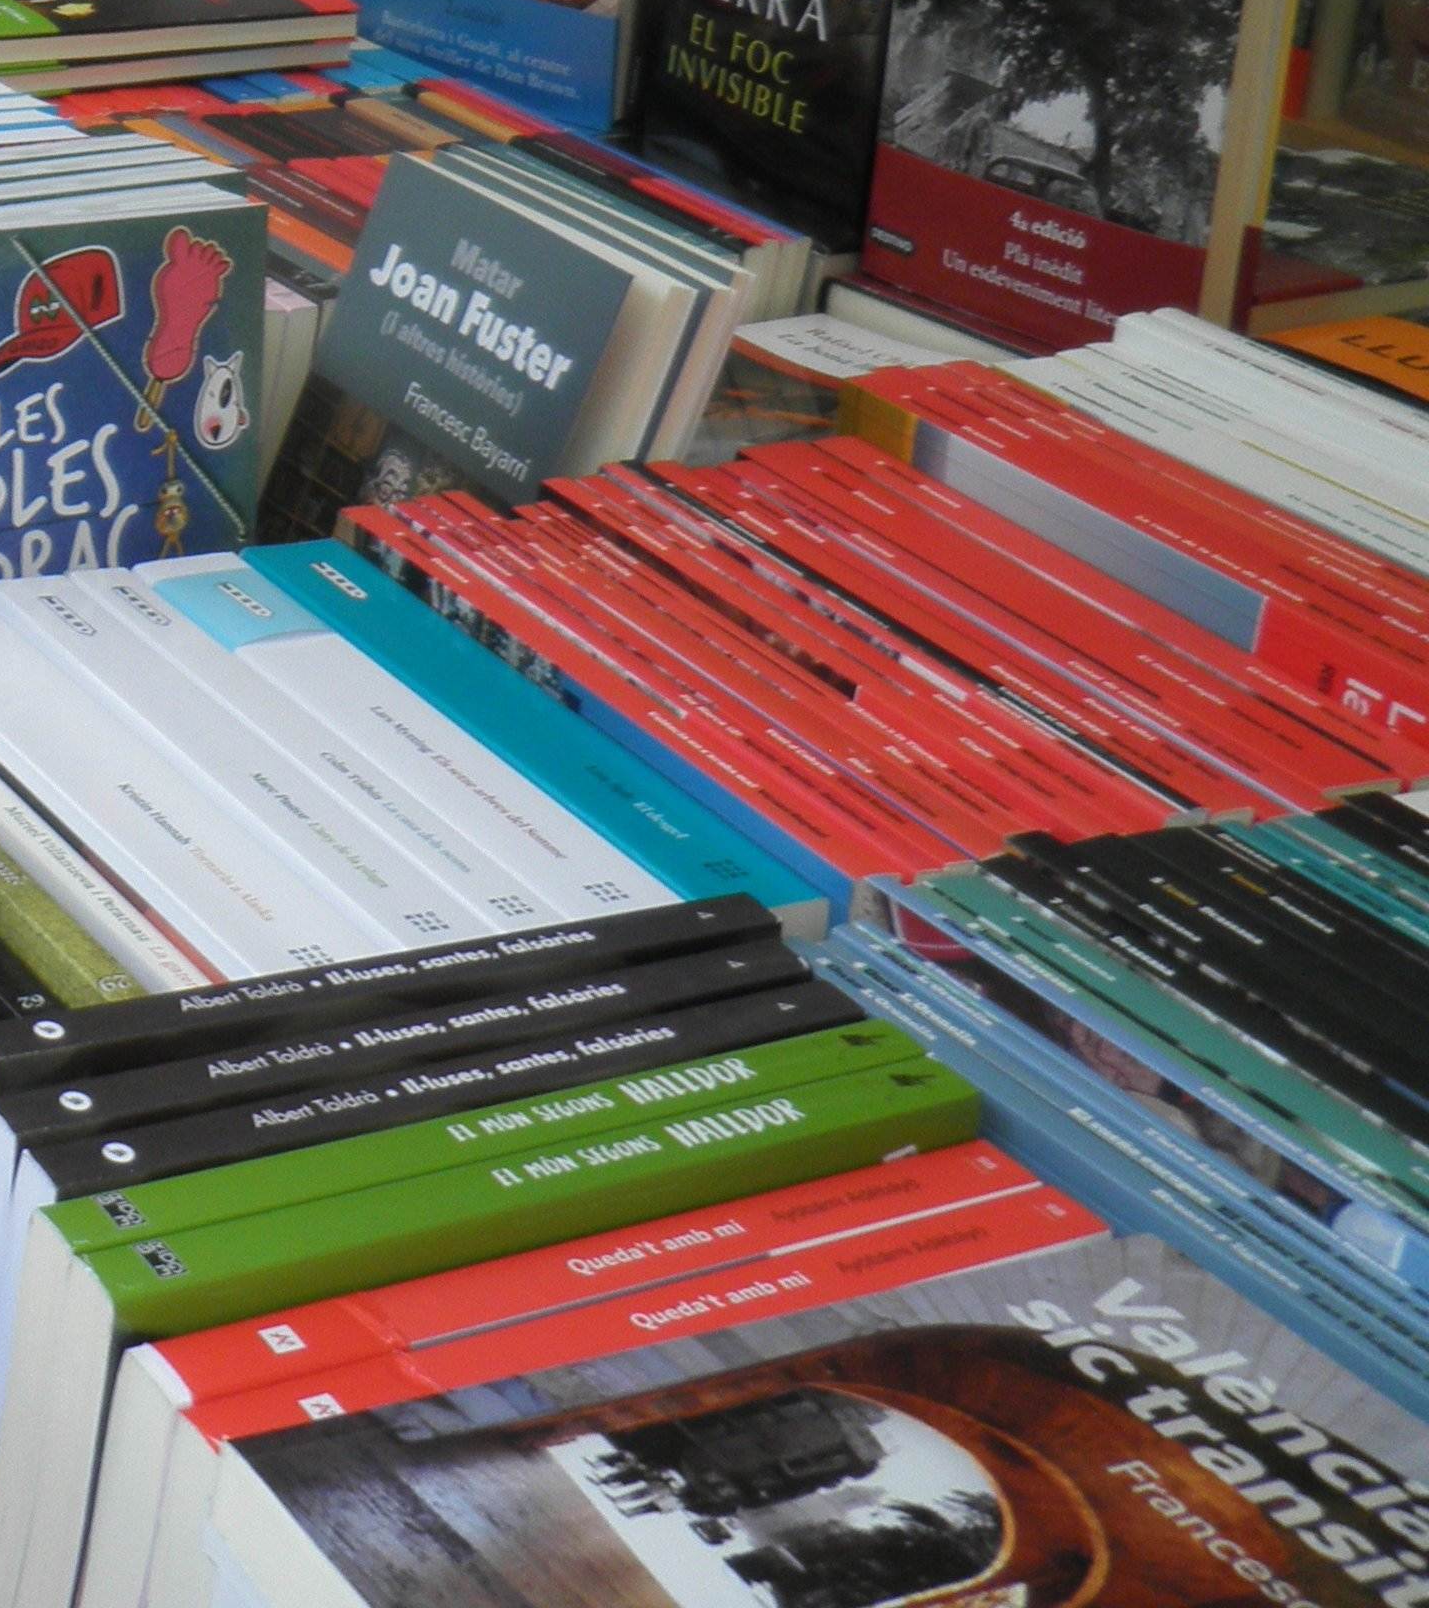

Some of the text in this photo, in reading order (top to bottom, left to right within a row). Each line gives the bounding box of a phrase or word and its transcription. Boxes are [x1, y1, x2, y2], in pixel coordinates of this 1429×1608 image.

[667, 44, 808, 135] INVISIBLE
[690, 13, 794, 84] EL FOC
[451, 238, 525, 301] Matar
[368, 243, 574, 391] Joan Fuster
[404, 381, 532, 482] Francesc Bayarri
[179, 989, 241, 1013] Albert
[237, 978, 305, 1003] Toldrà
[419, 946, 501, 972] santes,
[502, 928, 596, 957] falsàries
[206, 1055, 265, 1080] Albert
[267, 1041, 334, 1068] Toldrà
[448, 1002, 530, 1030] santes,
[530, 979, 627, 1013] falsàries
[252, 1104, 313, 1129] Albert
[314, 1088, 380, 1116] Toldrà
[496, 1051, 577, 1077] santes,
[577, 1024, 677, 1059] falsàries
[446, 1123, 476, 1143] EL
[531, 1092, 615, 1123] SEGONS
[618, 1057, 757, 1106] HALLDOR
[491, 1167, 523, 1188] EL
[577, 1134, 662, 1167] SEGONS
[663, 1098, 806, 1149] HALLDOR
[566, 1218, 747, 1277] Queda't amb mi
[629, 1271, 812, 1331] Queda't amb mi
[1005, 1298, 1138, 1383] sic
[1093, 1275, 1429, 1552] València
[1125, 1384, 1429, 1608] transit
